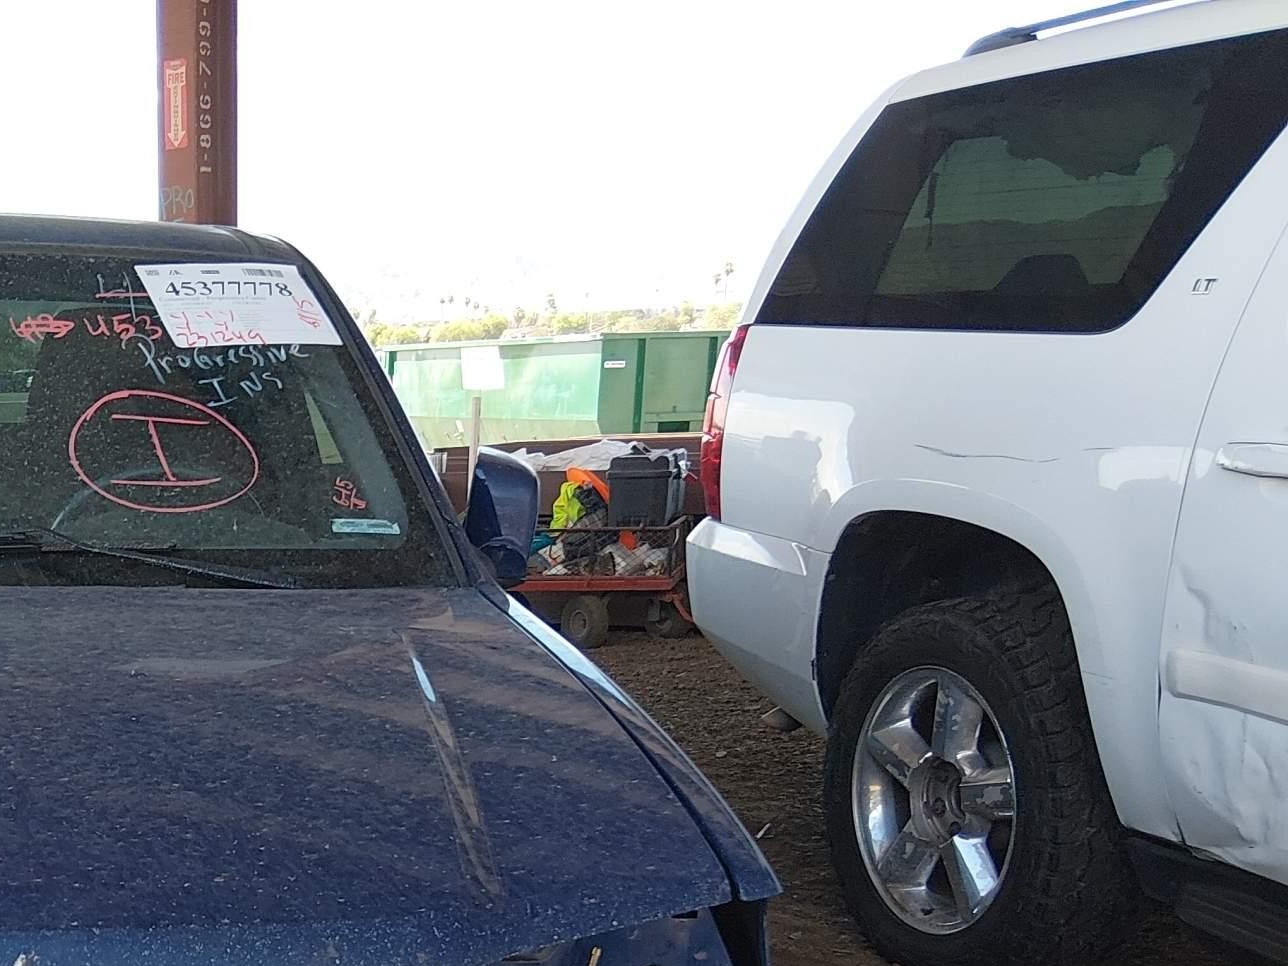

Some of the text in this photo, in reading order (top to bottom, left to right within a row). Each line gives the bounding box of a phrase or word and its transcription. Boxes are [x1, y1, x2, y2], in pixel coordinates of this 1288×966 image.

[167, 71, 186, 84] FIRE
[199, 0, 212, 173] 1-866-799-
[165, 281, 293, 297] 45377778
[1191, 278, 1219, 296] LT
